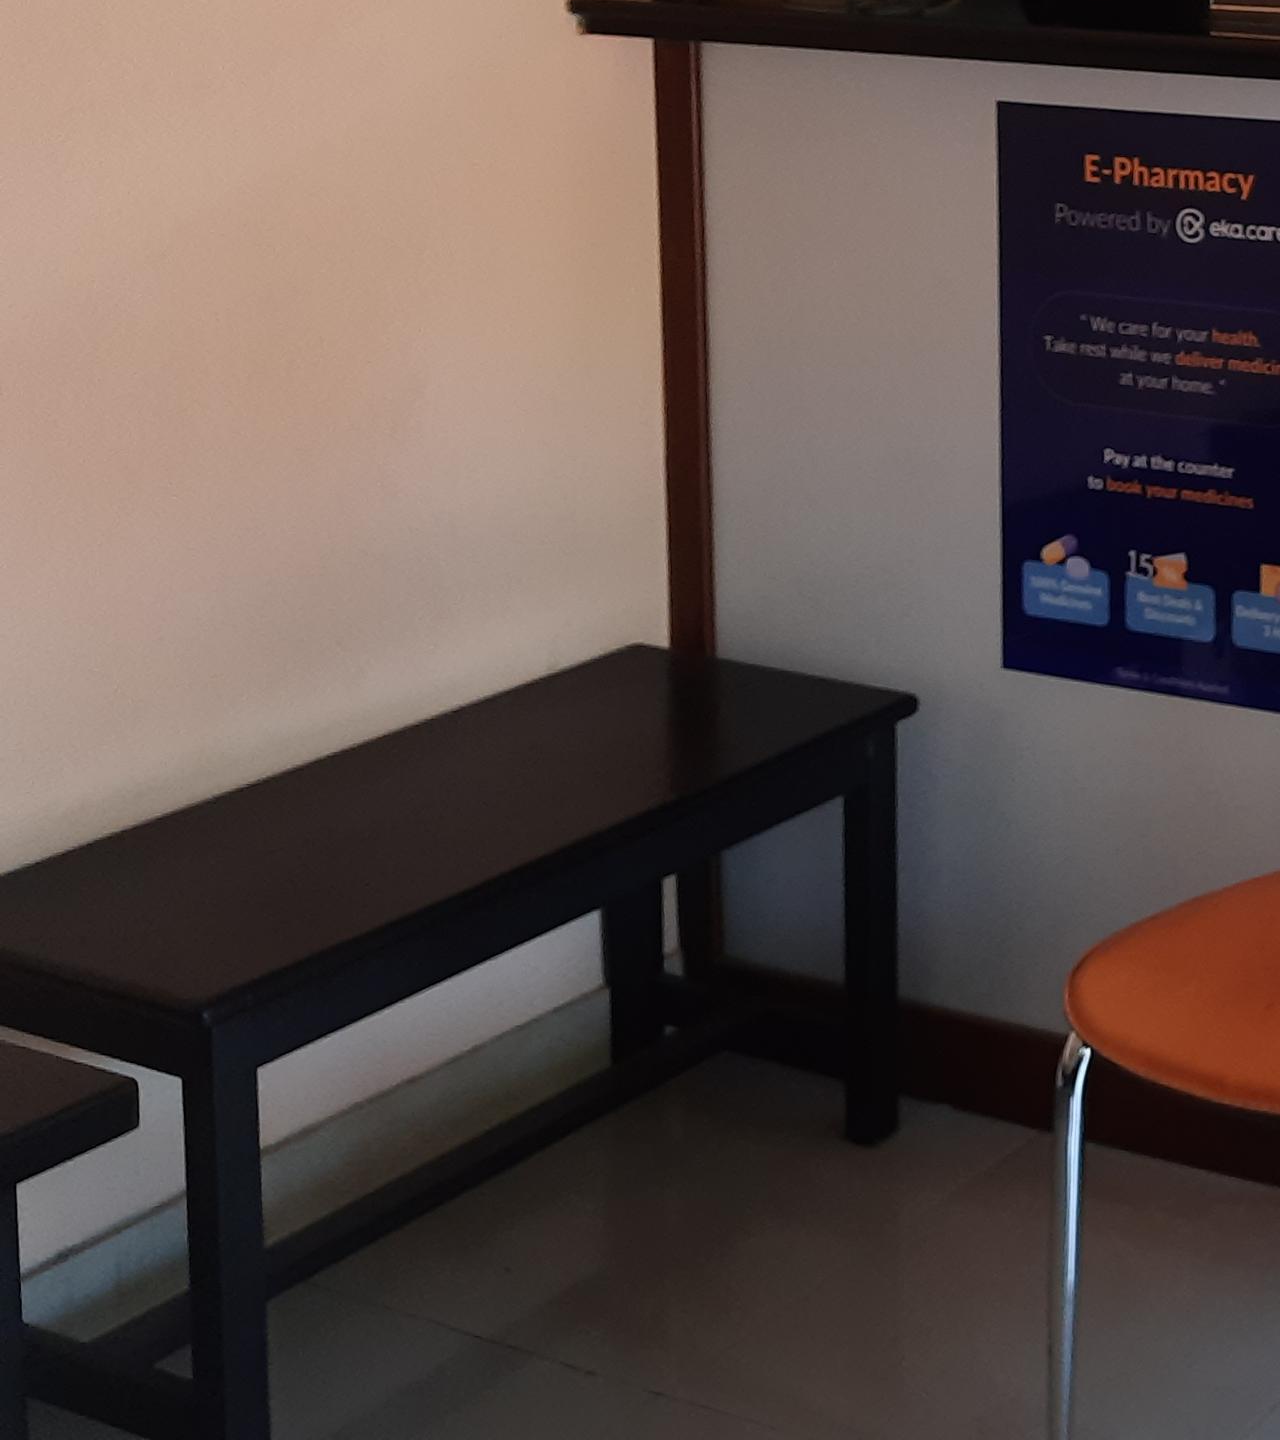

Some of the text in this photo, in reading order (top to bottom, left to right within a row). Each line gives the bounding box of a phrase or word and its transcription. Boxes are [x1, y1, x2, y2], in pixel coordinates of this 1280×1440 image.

[1083, 153, 1256, 201] E-Pharmacy
[1054, 202, 1142, 232] Powered
[1147, 210, 1173, 239] by
[1118, 320, 1149, 337] care
[1152, 321, 1173, 339] for
[1175, 329, 1209, 344] your
[1043, 335, 1078, 355] Take
[1079, 342, 1107, 358] rest
[1109, 344, 1147, 362] while
[1150, 351, 1173, 365] we
[1174, 351, 1223, 370] deliver
[1119, 371, 1134, 386] at
[1135, 375, 1169, 390] your
[1103, 447, 1235, 479] Pay at the counter
[1087, 474, 1255, 509] to book your medicines
